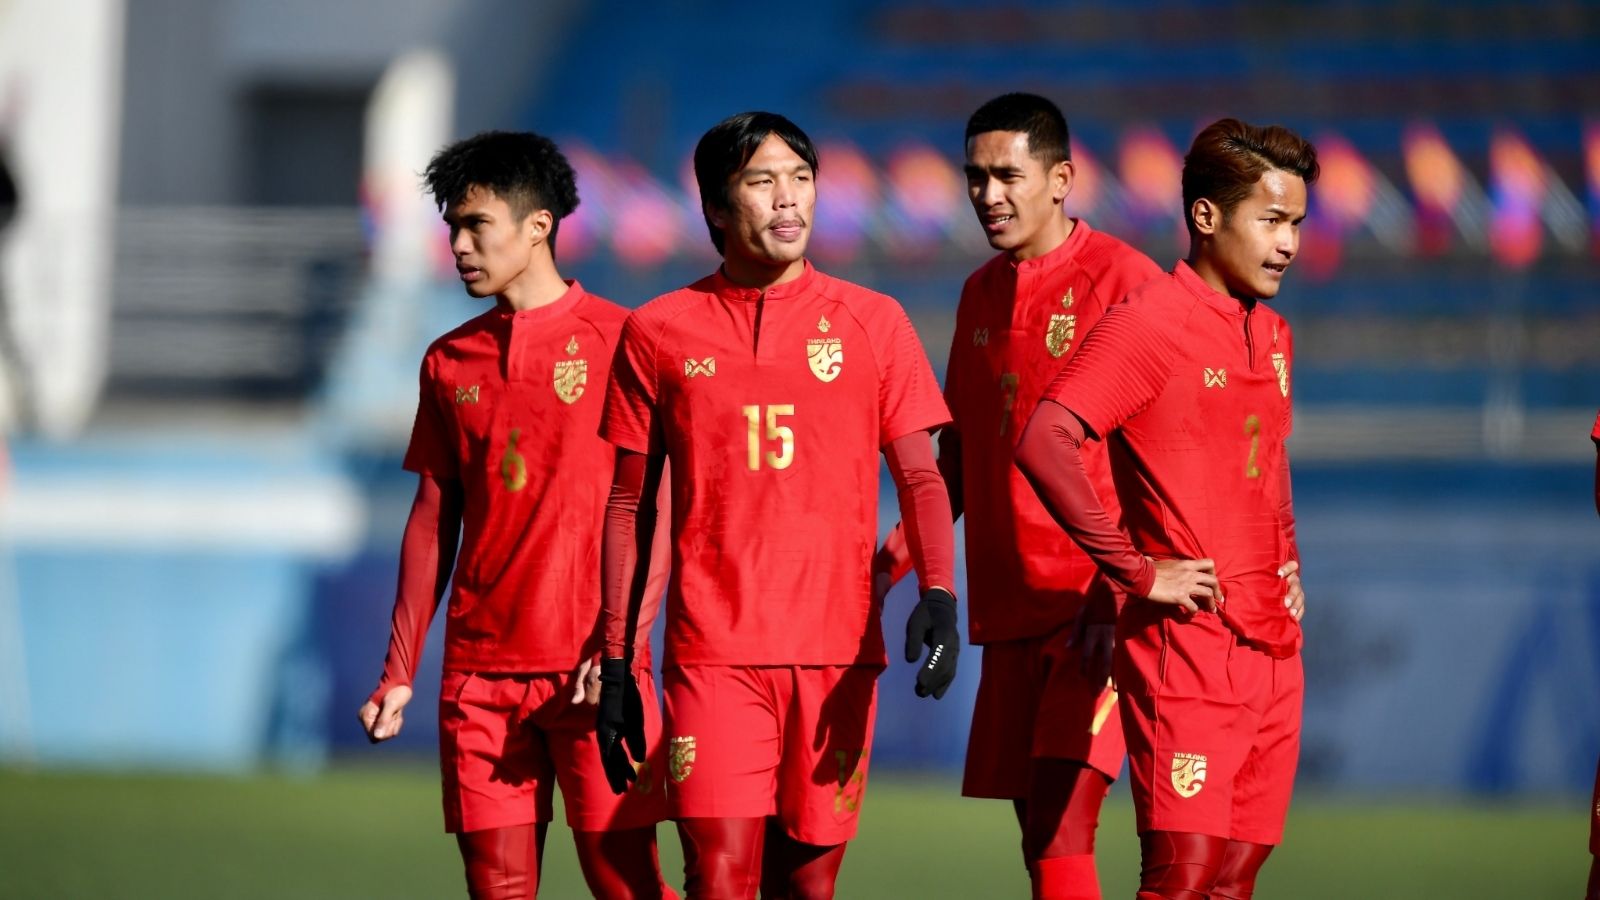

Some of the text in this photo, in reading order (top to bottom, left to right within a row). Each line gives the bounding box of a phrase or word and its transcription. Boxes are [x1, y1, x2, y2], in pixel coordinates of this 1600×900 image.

[502, 427, 528, 492] 6
[742, 403, 795, 471] 15
[1244, 414, 1261, 478] 2
[927, 644, 944, 670] KIPSTA
